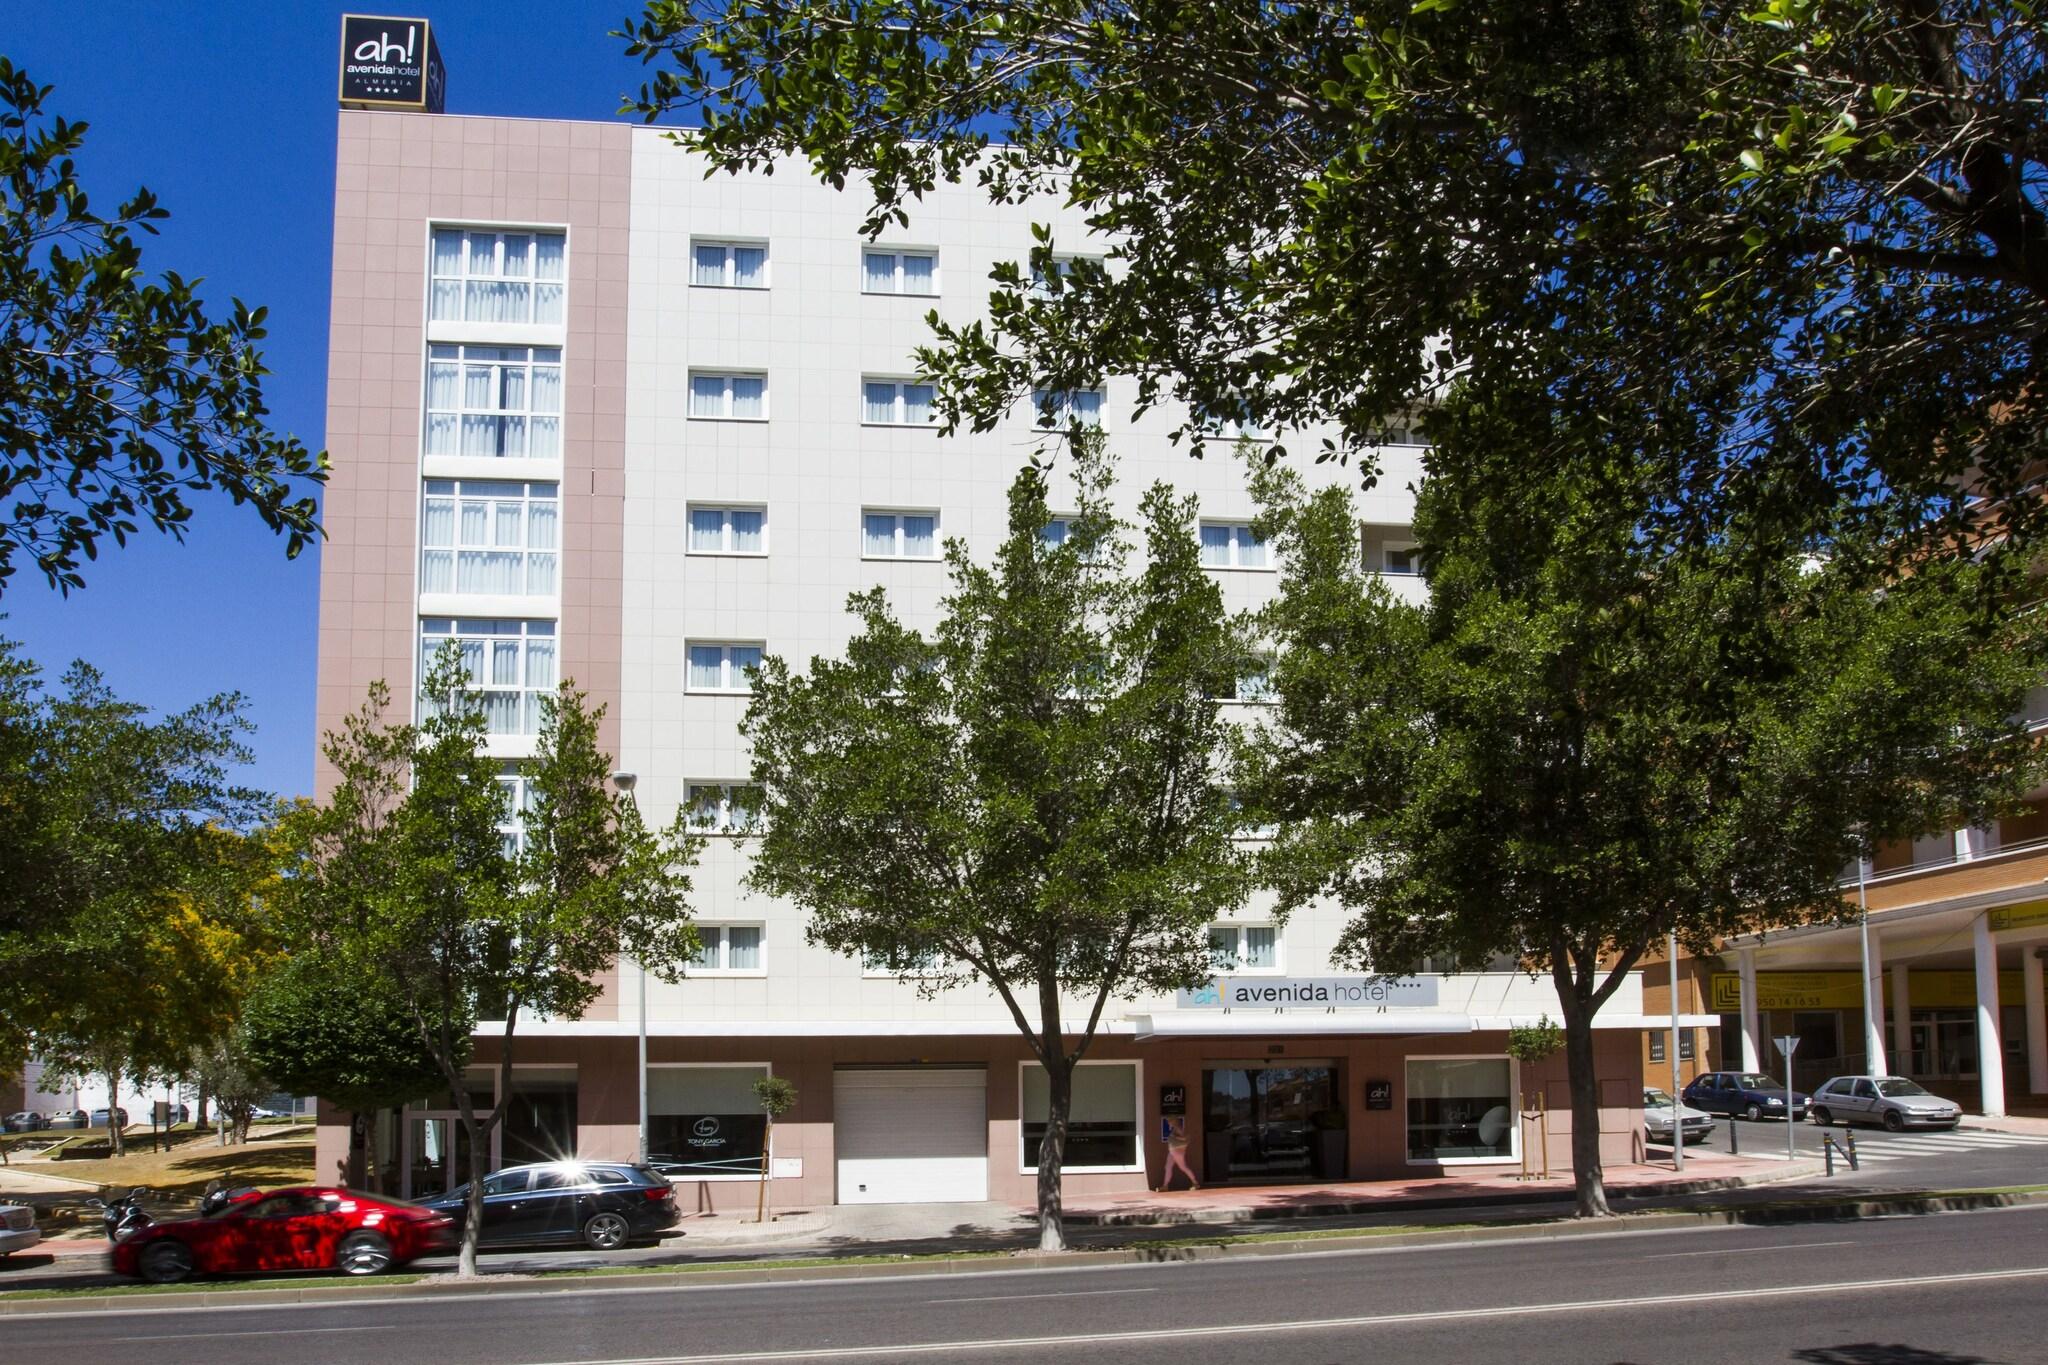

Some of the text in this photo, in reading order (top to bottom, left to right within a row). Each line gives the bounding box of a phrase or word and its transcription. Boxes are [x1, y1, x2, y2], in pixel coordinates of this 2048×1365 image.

[354, 25, 415, 64] ah!
[347, 64, 420, 76] avenidahotel
[1236, 983, 1328, 1002] avenida
[1334, 983, 1390, 1001] hotel
